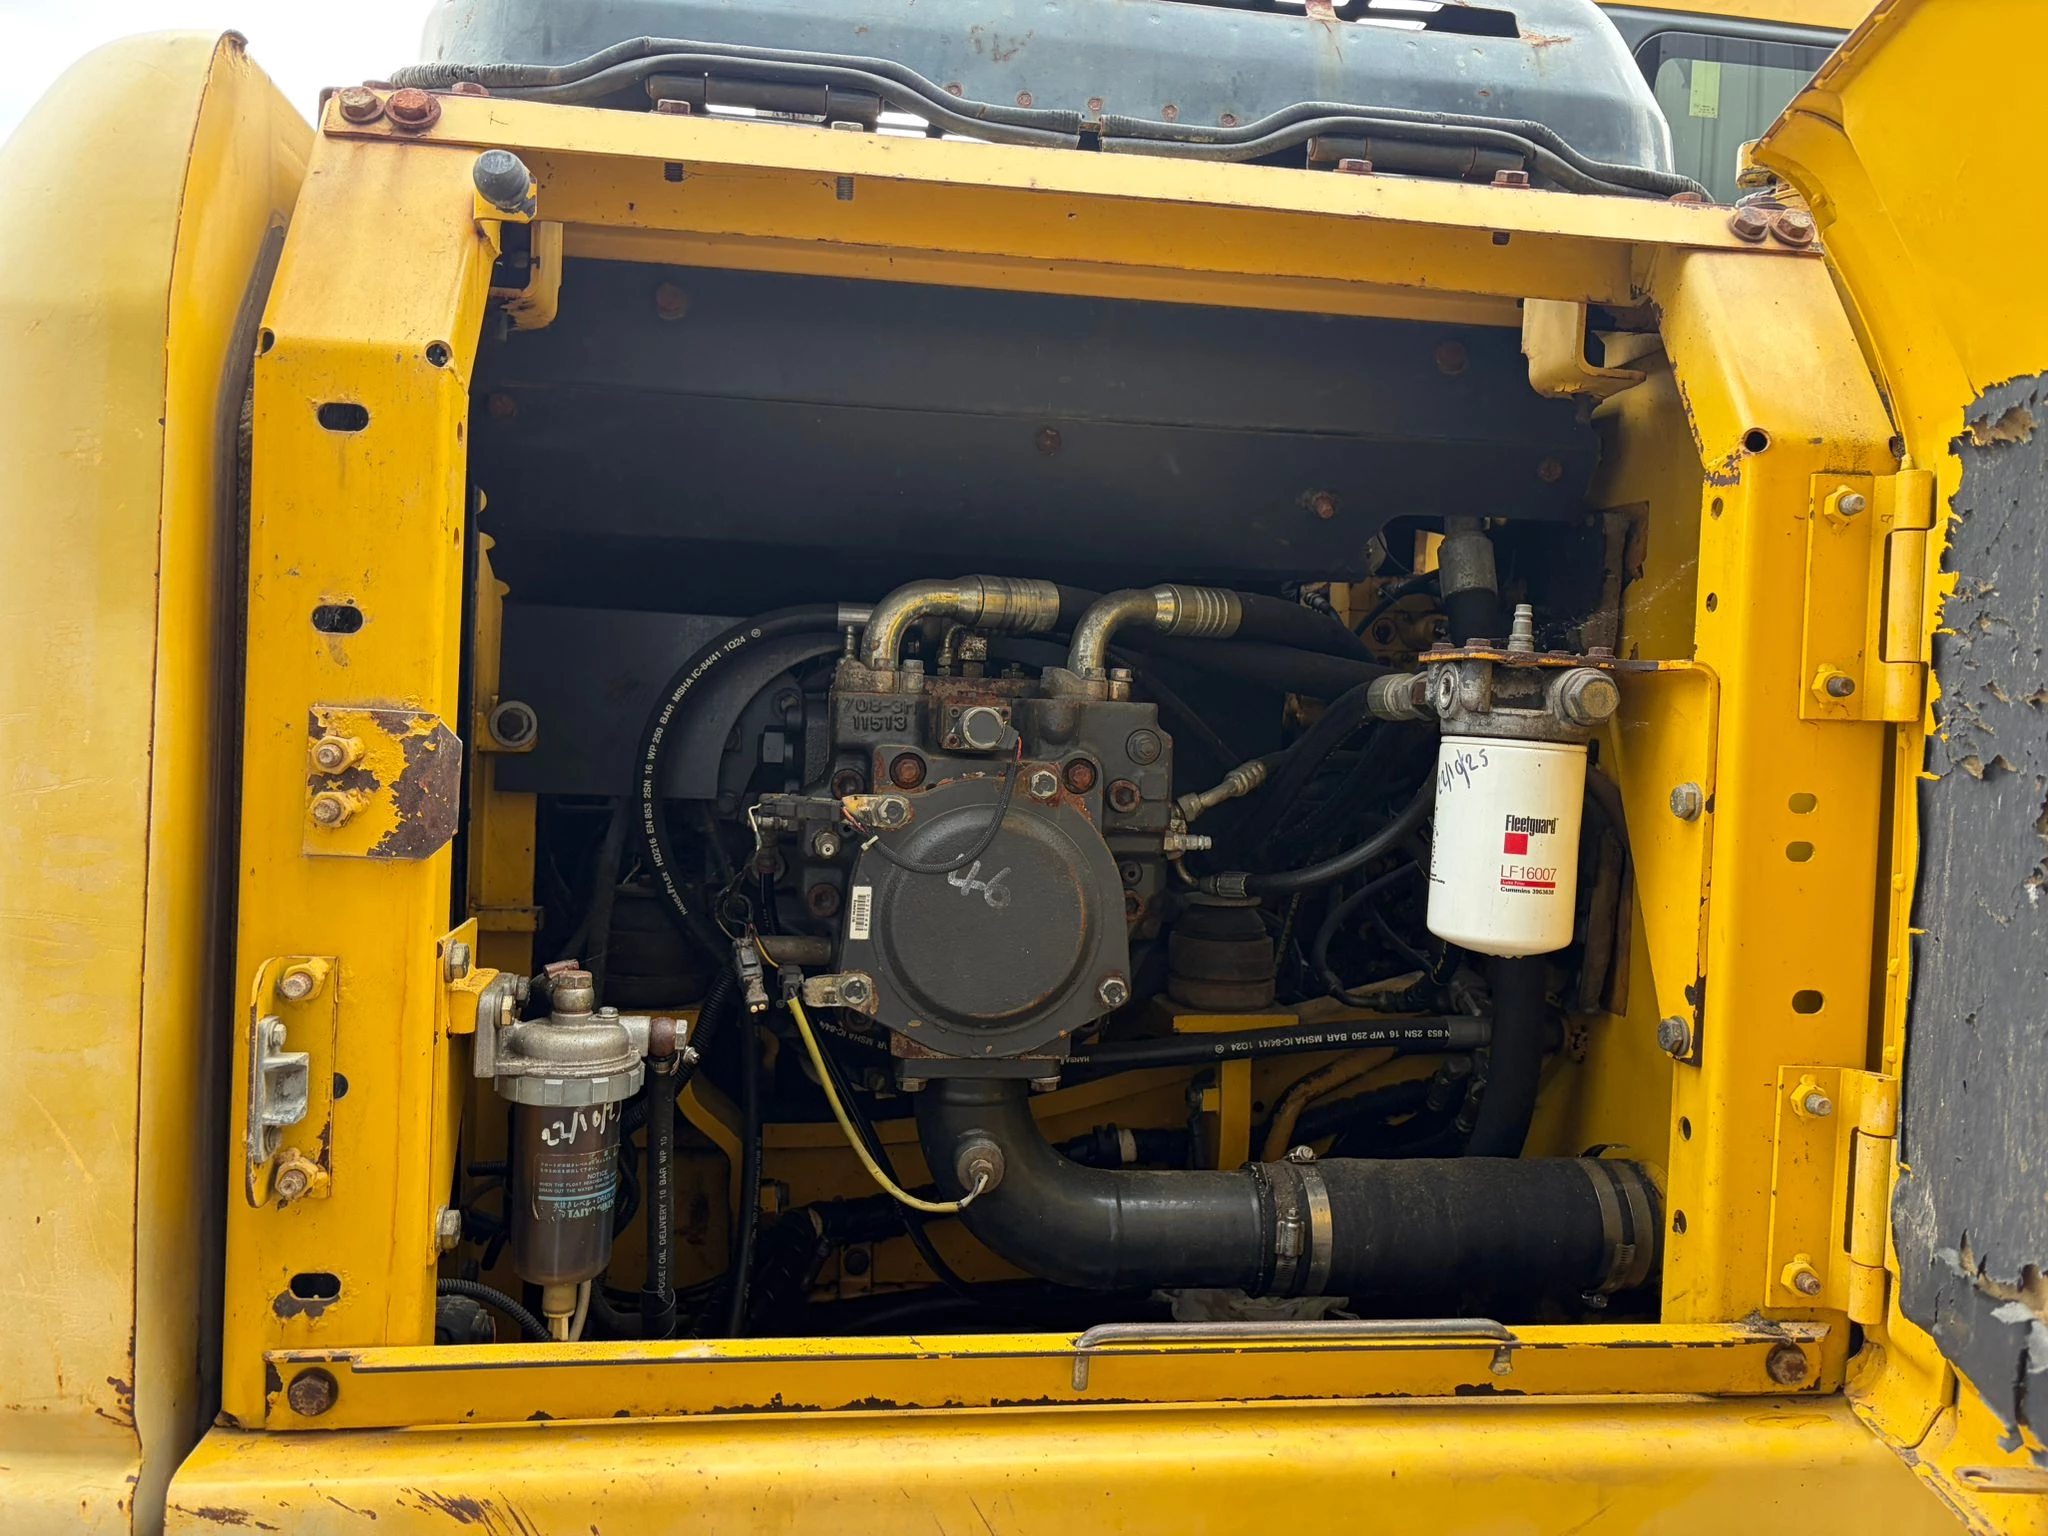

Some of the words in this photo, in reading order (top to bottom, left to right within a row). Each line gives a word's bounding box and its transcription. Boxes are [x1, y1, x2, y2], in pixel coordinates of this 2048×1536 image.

[723, 635, 746, 652] 1Q24
[691, 651, 722, 680] IC-84/41
[671, 677, 695, 703] MSHA
[659, 703, 675, 725] BAR
[652, 727, 664, 744] 250
[647, 744, 656, 761] WP
[644, 764, 654, 774] 16
[643, 779, 652, 799] 2SN
[643, 802, 653, 819] 853
[645, 820, 655, 834] EN
[1505, 814, 1558, 837] Fleetguard
[649, 837, 664, 867] HD216
[1500, 864, 1557, 881] LF16007
[1500, 886, 1531, 894] Cummins
[848, 1033, 875, 1046] MSHA
[1296, 1033, 1323, 1044] MSHA
[1326, 1032, 1347, 1042] BAR
[1351, 1031, 1368, 1040] 250
[1369, 1031, 1385, 1040] WP
[1389, 1030, 1400, 1038] 16
[1404, 1029, 1423, 1038] 2SN
[1427, 1029, 1443, 1038] 853
[1230, 1042, 1253, 1051] 1Q24
[1258, 1037, 1294, 1048] IC-84/41
[659, 1150, 667, 1164] WP
[587, 1169, 609, 1180] NOTICE
[659, 1167, 667, 1186] BAR
[566, 1180, 582, 1188] FLOAT
[659, 1204, 667, 1246] DELIVERY
[659, 1249, 667, 1264] OIL
